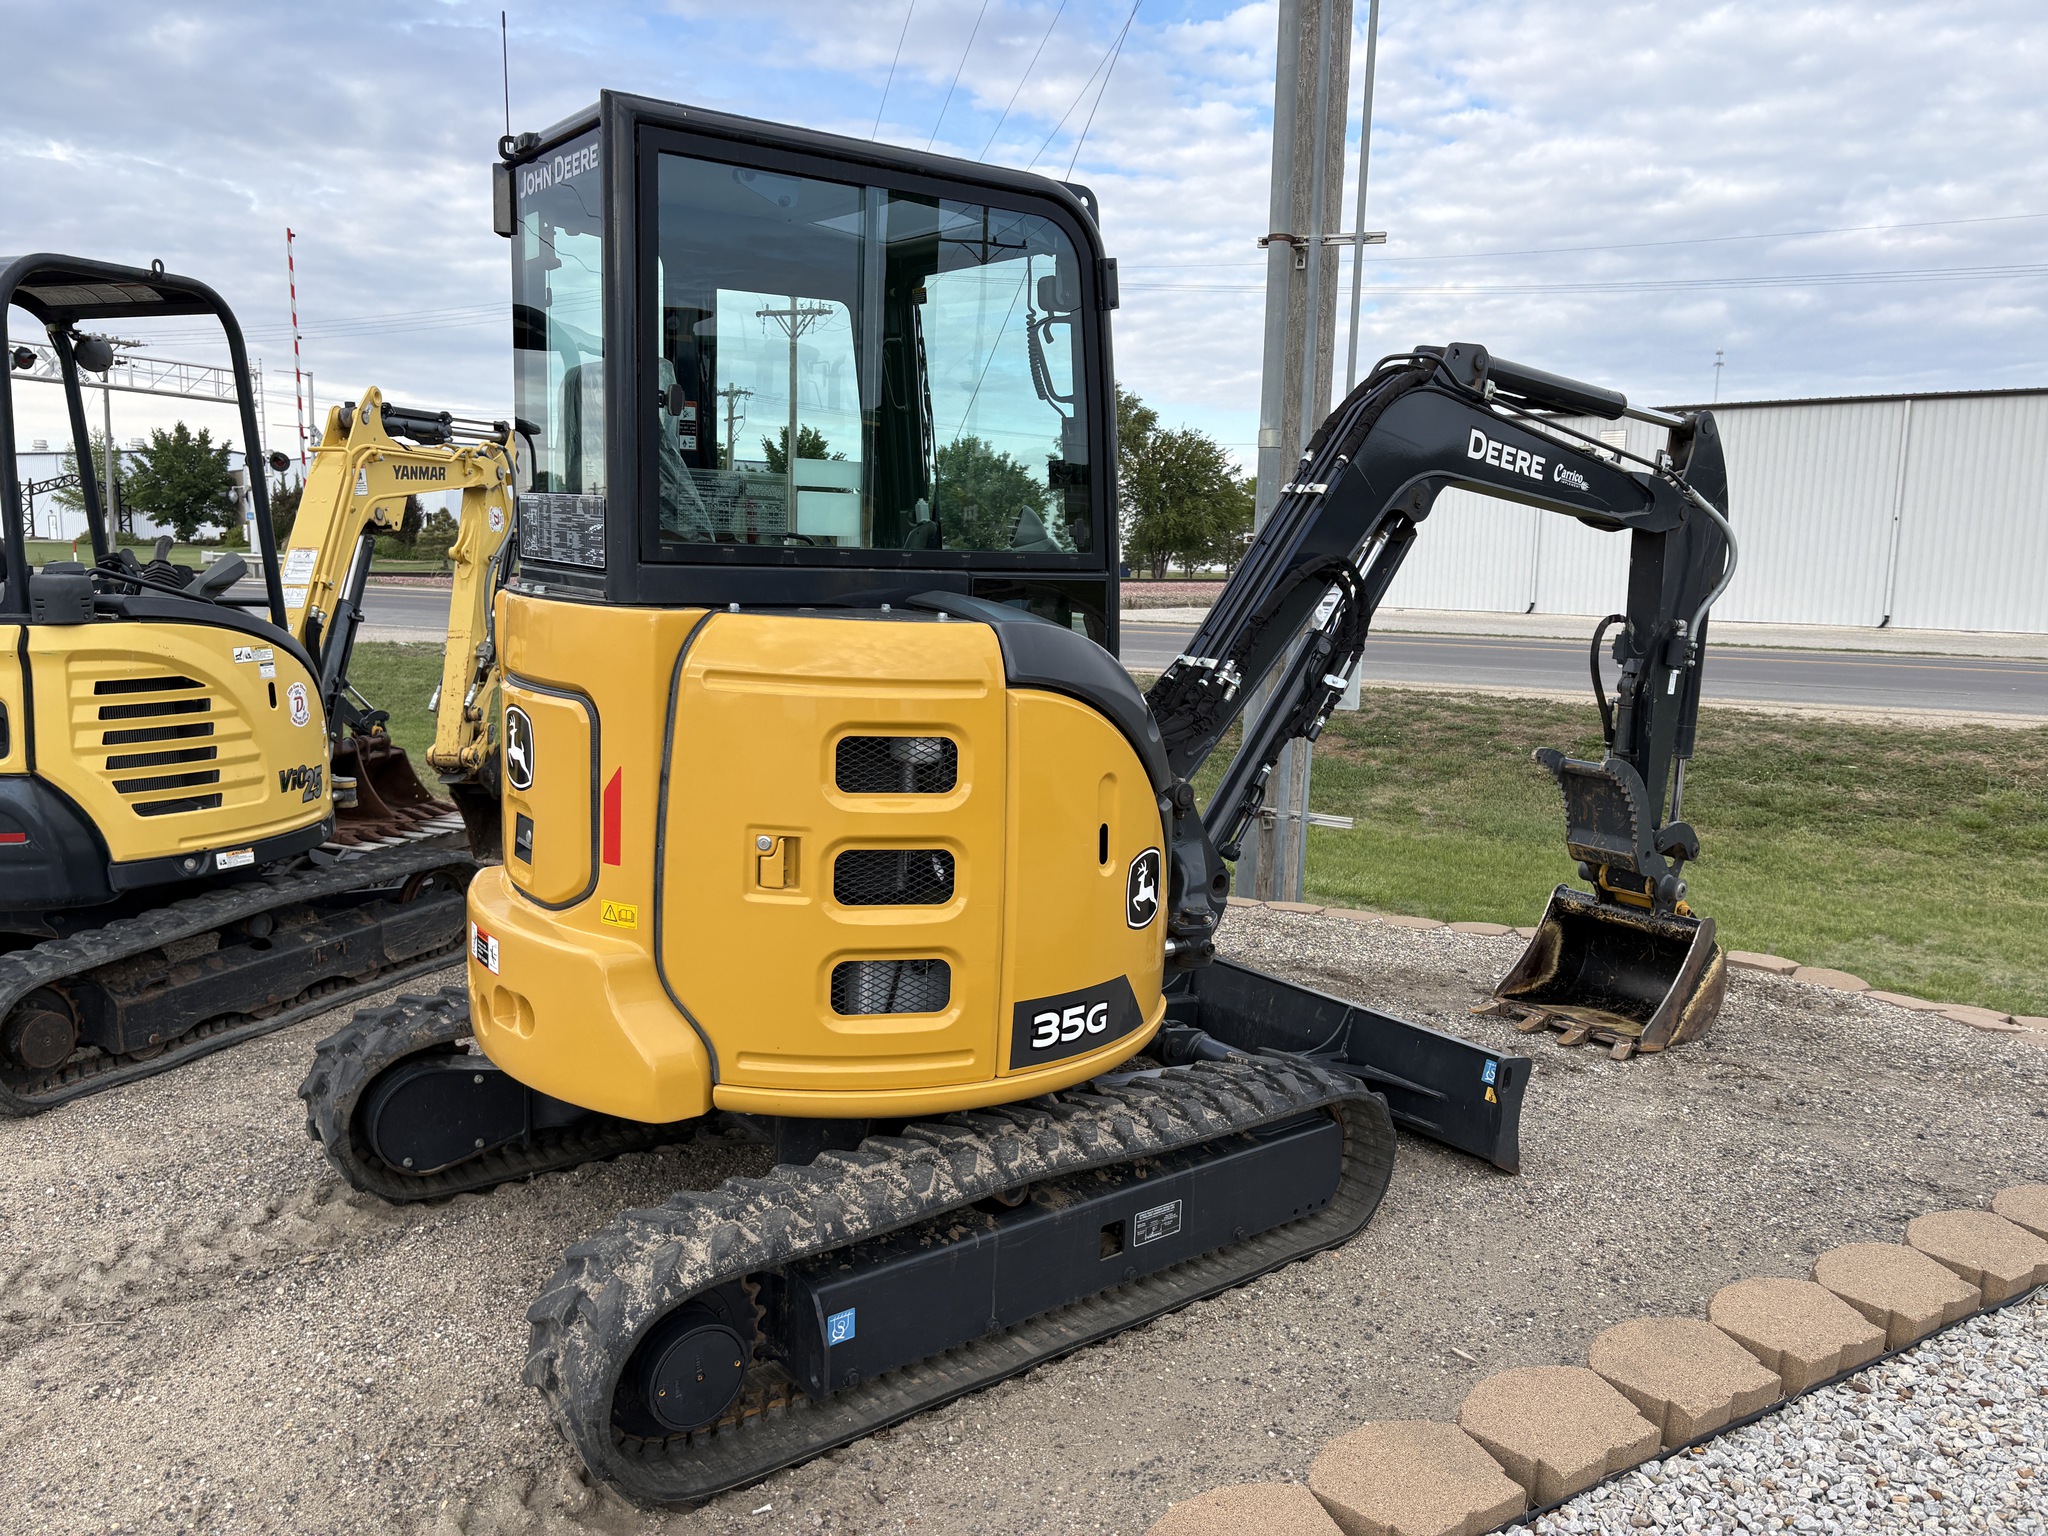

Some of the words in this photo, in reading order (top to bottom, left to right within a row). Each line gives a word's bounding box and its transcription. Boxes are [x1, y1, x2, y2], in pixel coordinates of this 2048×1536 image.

[520, 164, 552, 199] JOHN
[555, 143, 599, 184] DEERE
[393, 465, 446, 481] YANMAR
[1467, 428, 1546, 480] DEERE
[1554, 463, 1584, 483] Carrico
[1032, 1002, 1108, 1048] 35G
